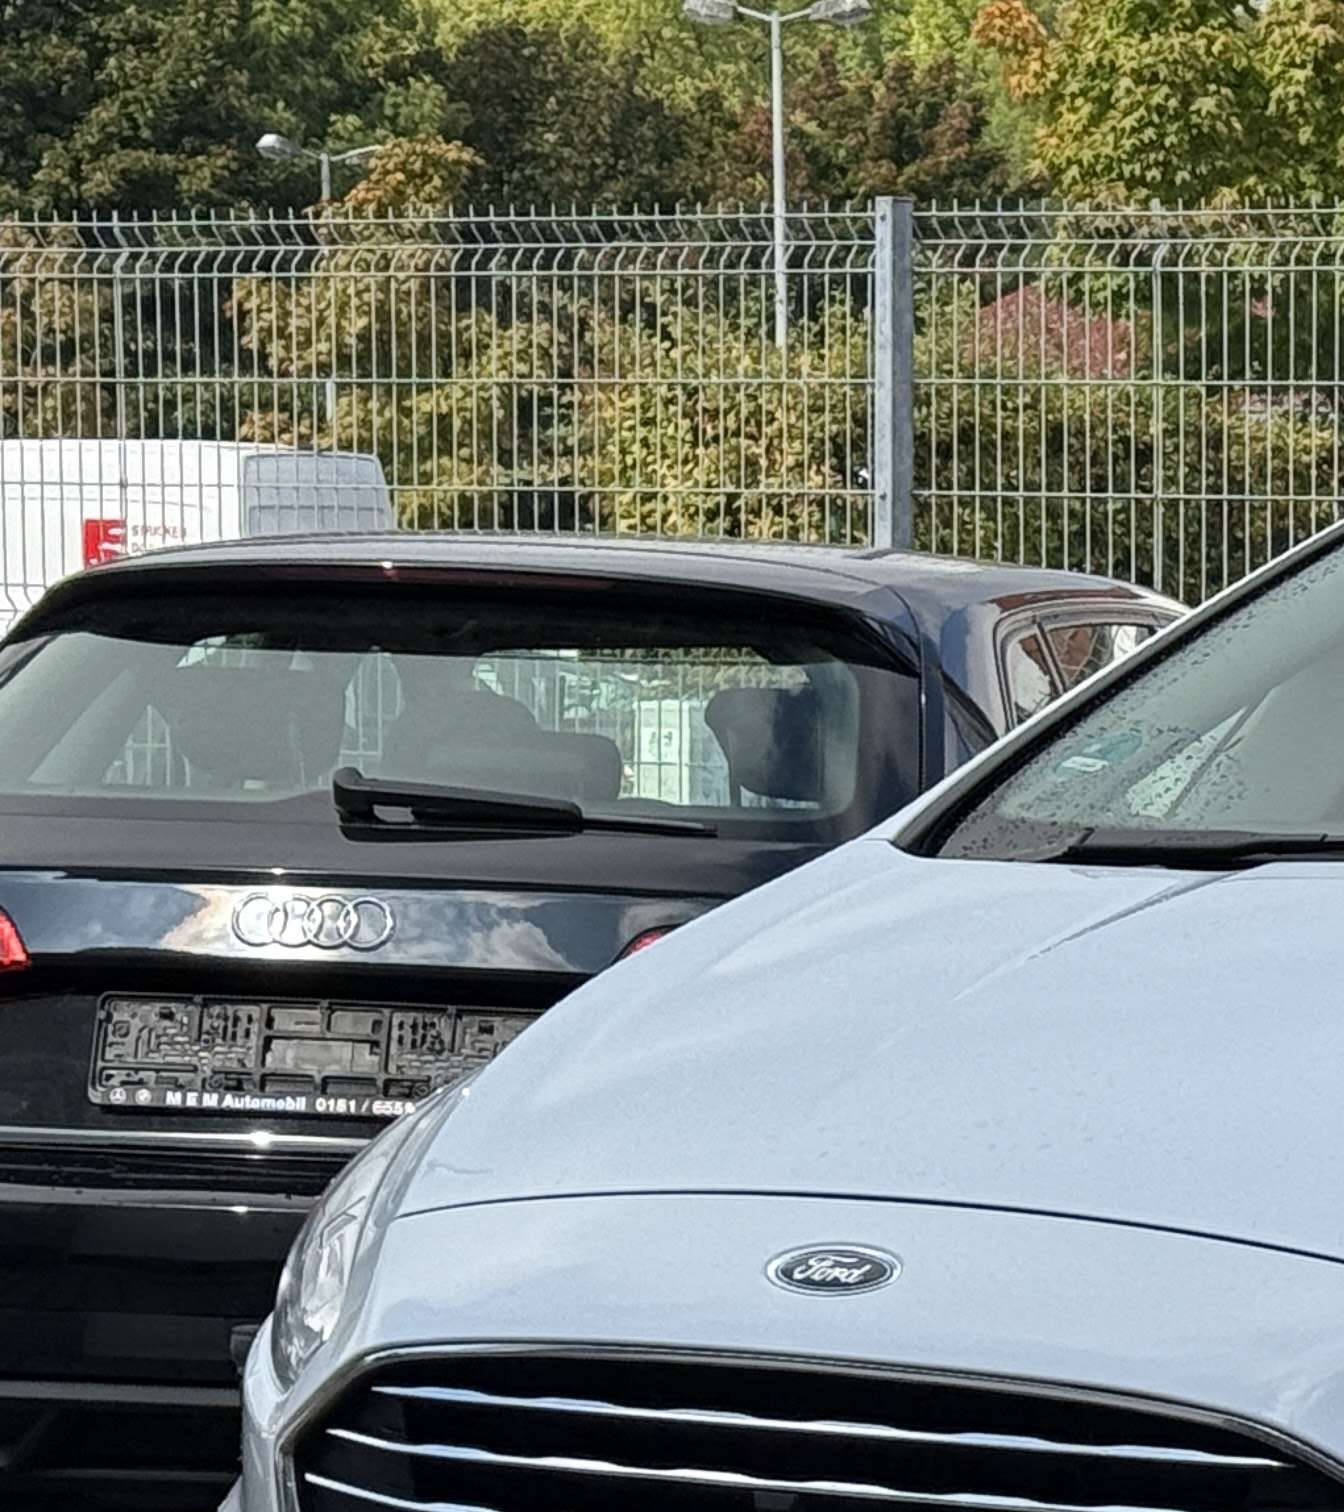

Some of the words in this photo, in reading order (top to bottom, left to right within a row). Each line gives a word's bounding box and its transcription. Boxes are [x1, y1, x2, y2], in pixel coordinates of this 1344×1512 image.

[165, 1090, 183, 1105] M
[202, 1092, 219, 1107] M
[315, 1097, 356, 1113] 0151
